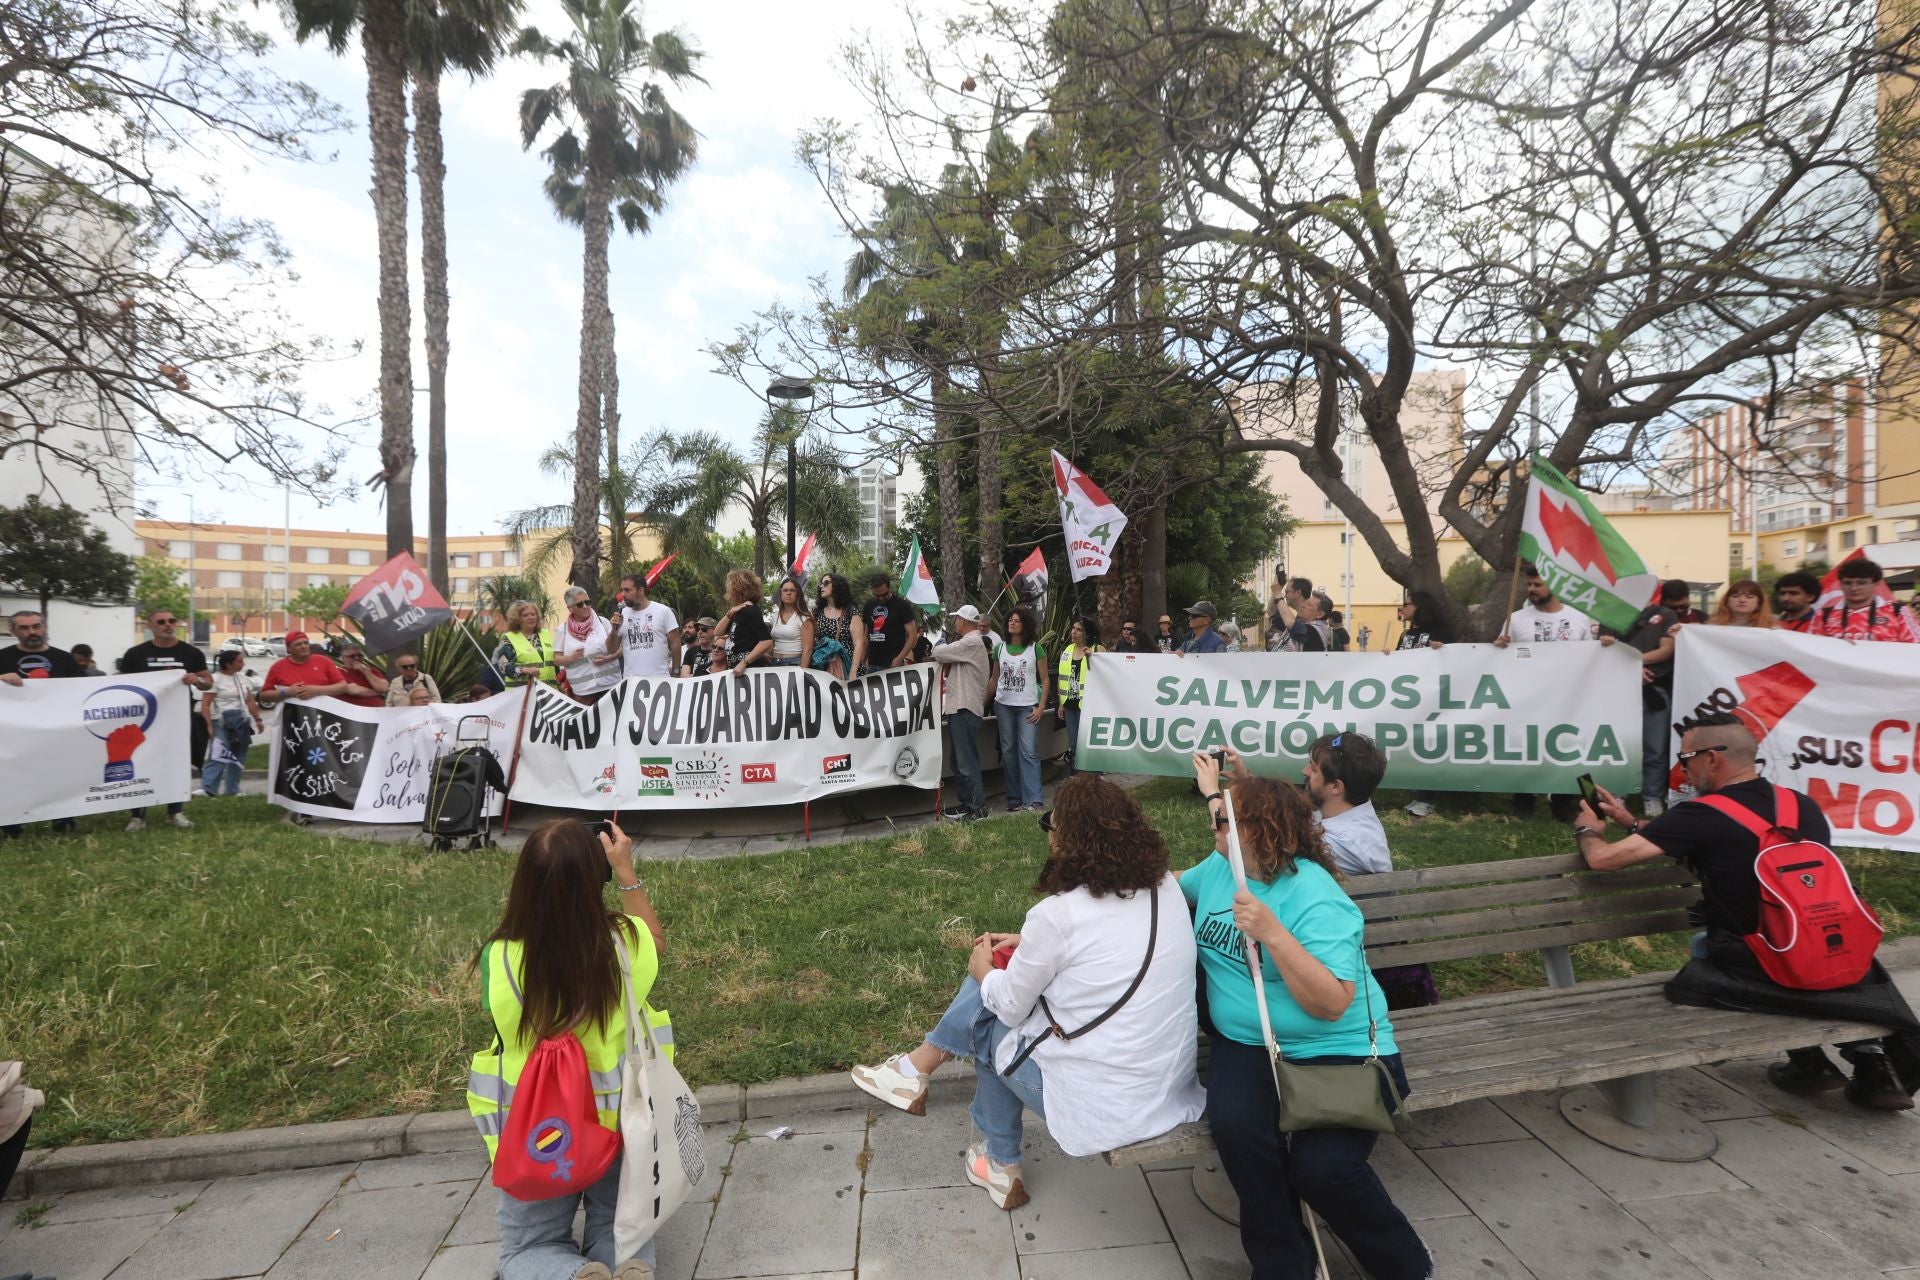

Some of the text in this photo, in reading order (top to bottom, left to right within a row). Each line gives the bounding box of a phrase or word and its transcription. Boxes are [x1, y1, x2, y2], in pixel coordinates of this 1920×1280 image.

[1534, 549, 1598, 612] USTEA
[1155, 673, 1512, 711] SALVEMOS LA
[83, 704, 146, 721] ACERINOX
[610, 679, 629, 746] Y
[628, 671, 822, 746] SOLIDARIDAD
[829, 667, 936, 740] OBRERA
[283, 713, 365, 764] AMIGAS
[1375, 712, 1625, 763] PÚBLICA
[744, 767, 772, 780] CTA
[826, 758, 848, 769] CNT
[89, 778, 151, 793] SINDICALISMO
[641, 779, 673, 789] USTEA
[675, 779, 721, 787] SINDICAL
[1808, 777, 1914, 836] NO
